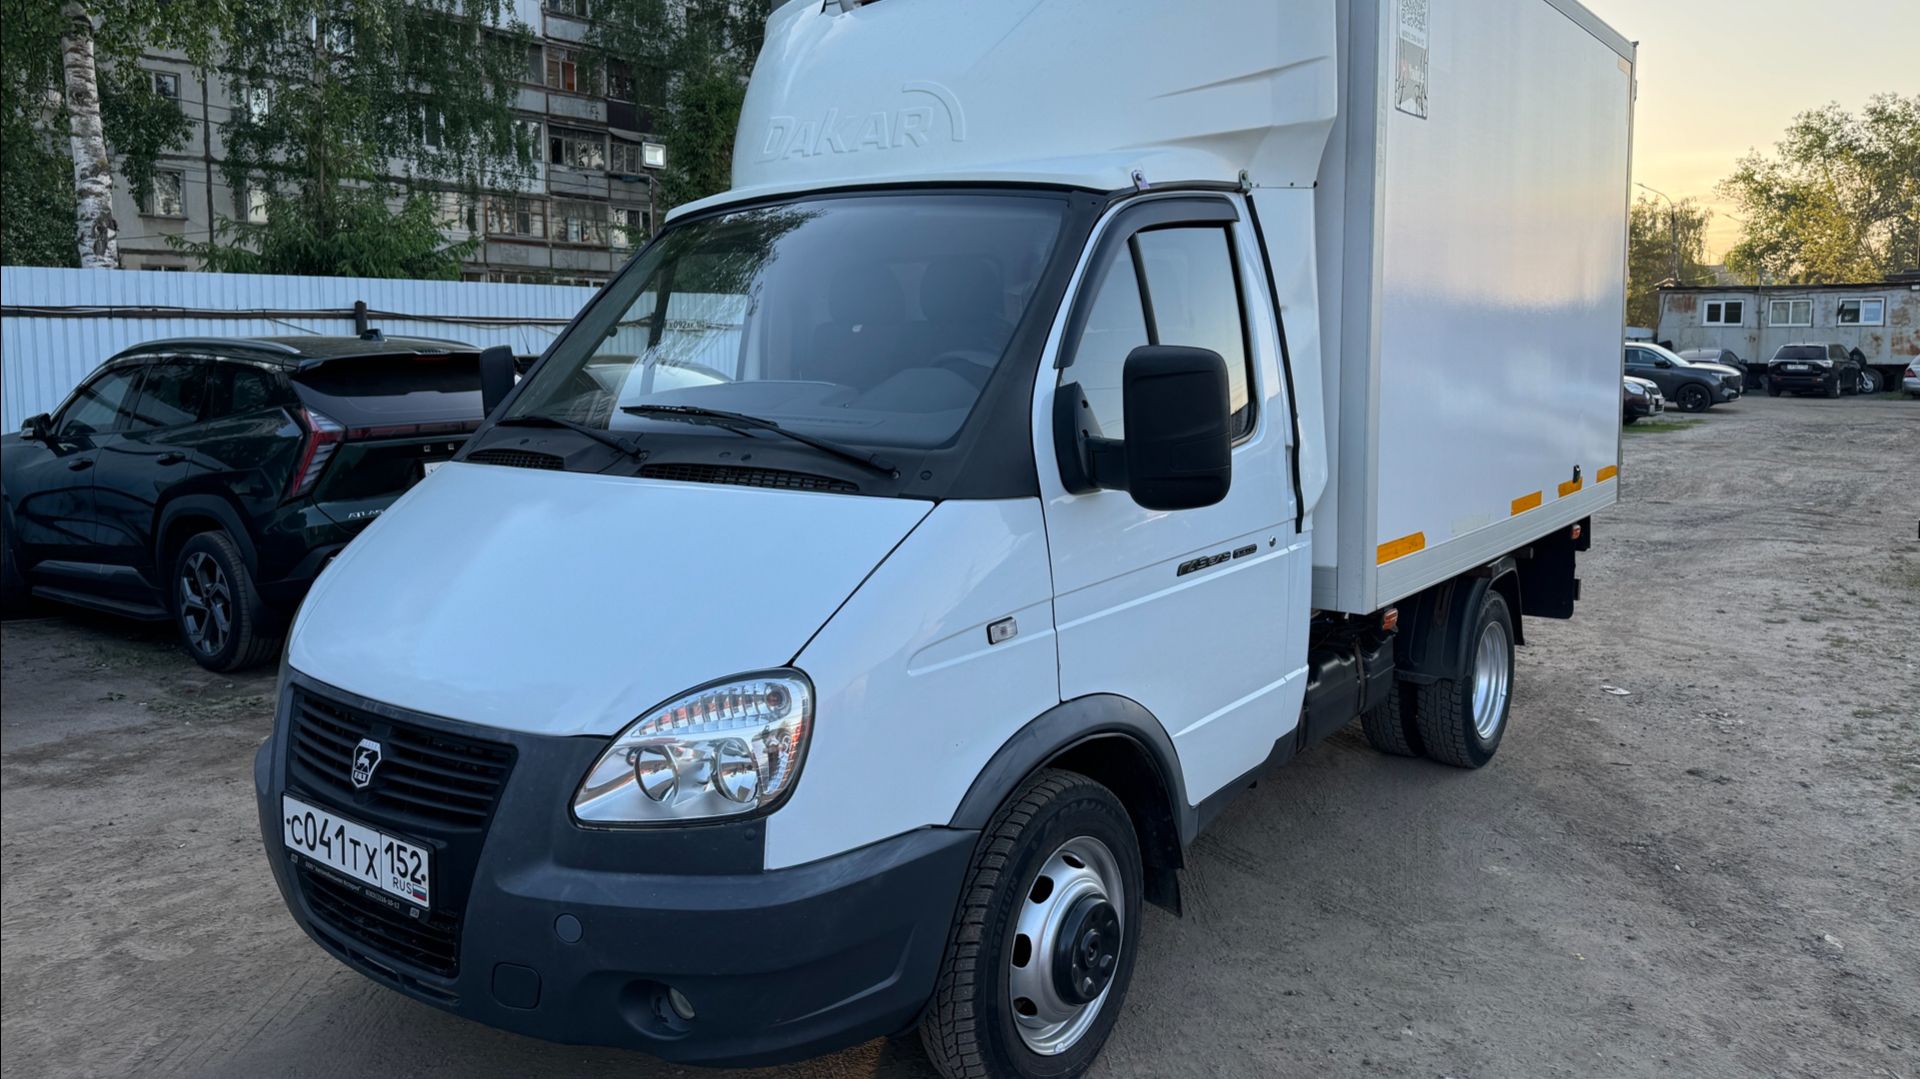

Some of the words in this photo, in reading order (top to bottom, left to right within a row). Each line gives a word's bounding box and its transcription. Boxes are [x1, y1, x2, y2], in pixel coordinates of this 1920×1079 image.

[755, 106, 933, 164] DAKAR
[384, 841, 422, 885] 152
[393, 876, 413, 895] RUS
